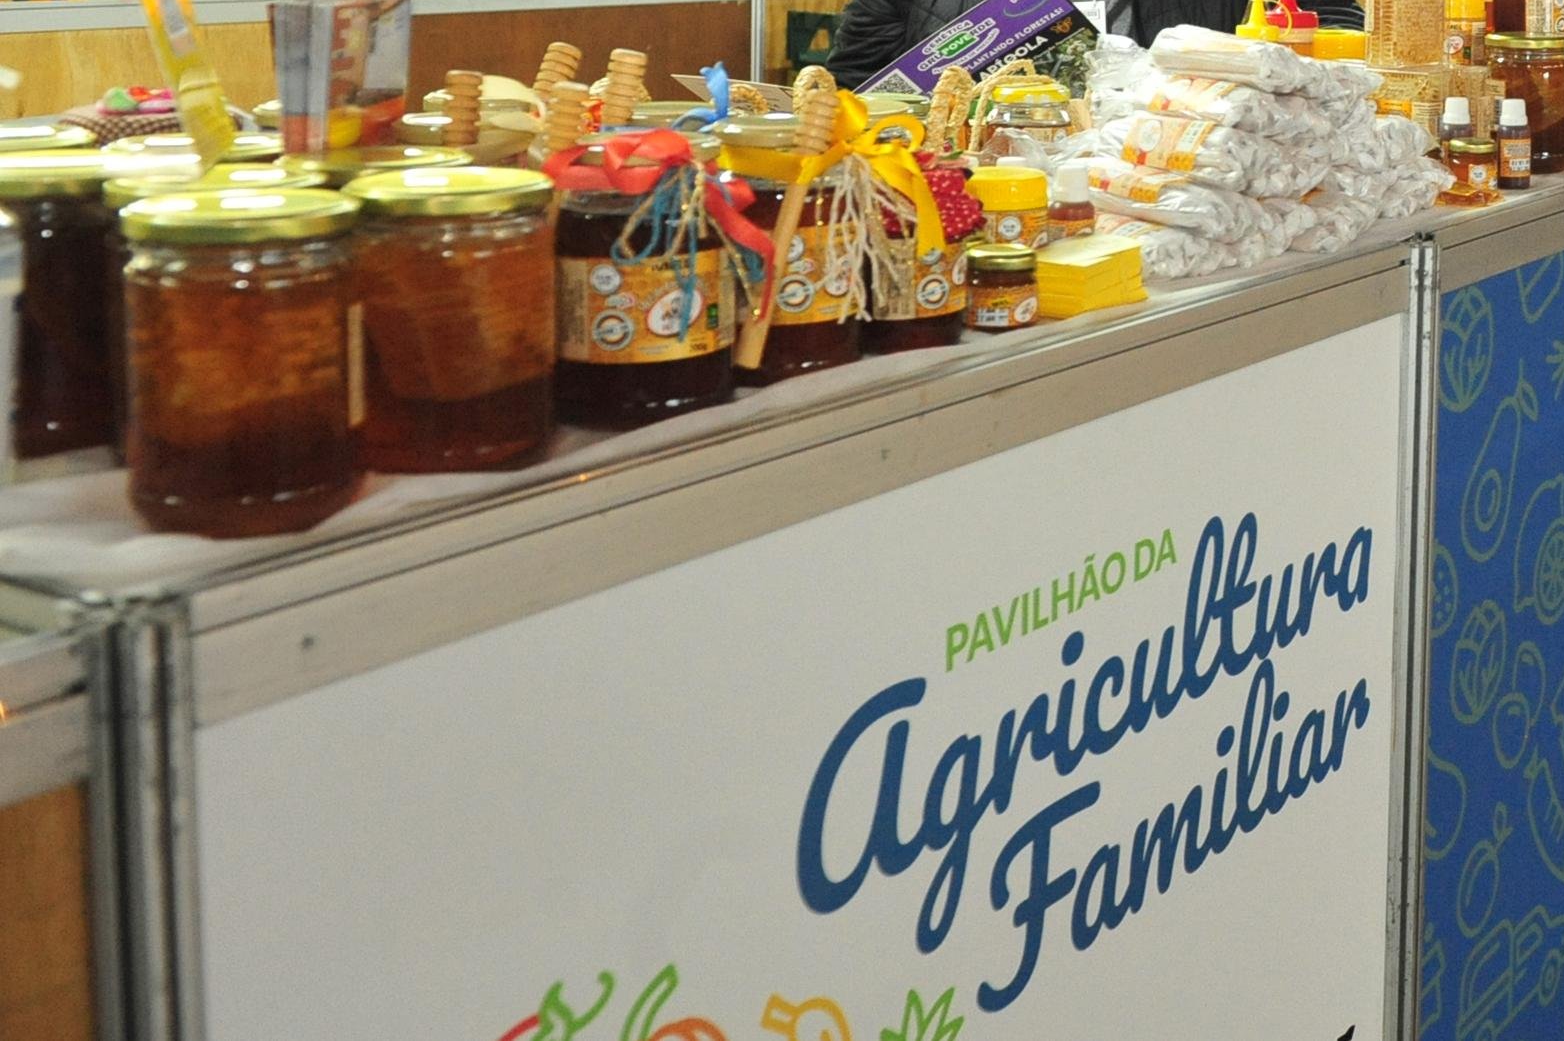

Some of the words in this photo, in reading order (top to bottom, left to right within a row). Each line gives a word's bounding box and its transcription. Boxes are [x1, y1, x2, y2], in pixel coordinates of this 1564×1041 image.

[923, 21, 972, 54] GENÉTICA
[943, 553, 1127, 673] PAVILHÃO
[1133, 528, 1178, 584] DA
[796, 511, 1374, 955] Agricultura
[976, 658, 1372, 1014] Familiar
